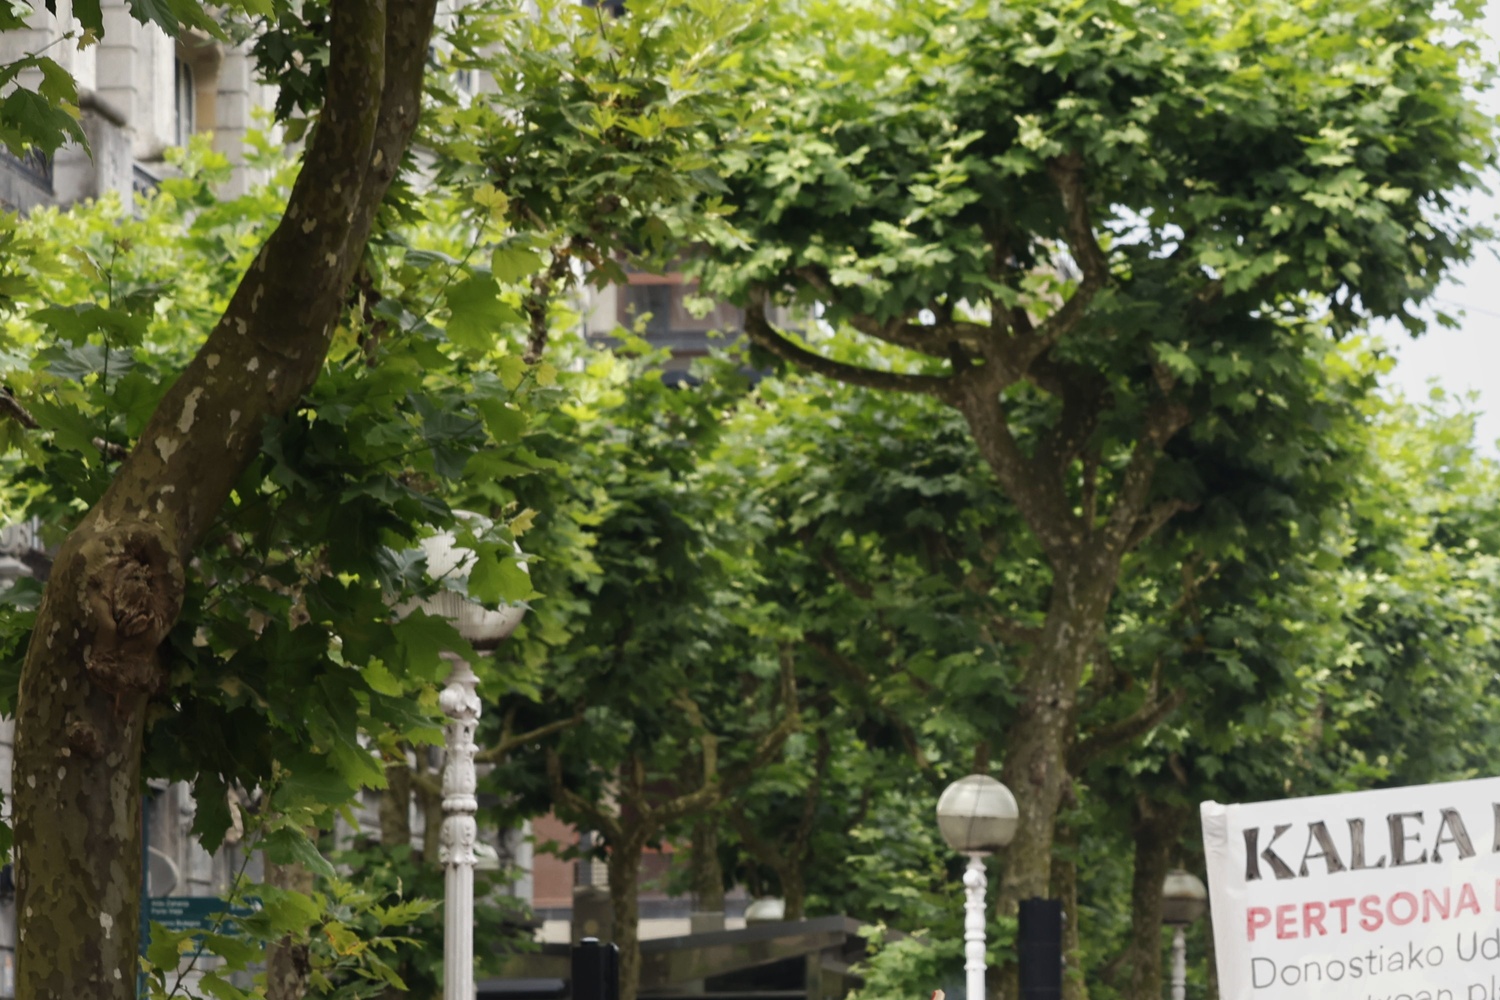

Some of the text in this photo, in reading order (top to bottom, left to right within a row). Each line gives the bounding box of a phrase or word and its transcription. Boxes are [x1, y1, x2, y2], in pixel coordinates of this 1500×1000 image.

[1243, 806, 1476, 882] KALEA
[1246, 882, 1481, 943] PERTSONA
[1251, 940, 1445, 989] Donostiako
